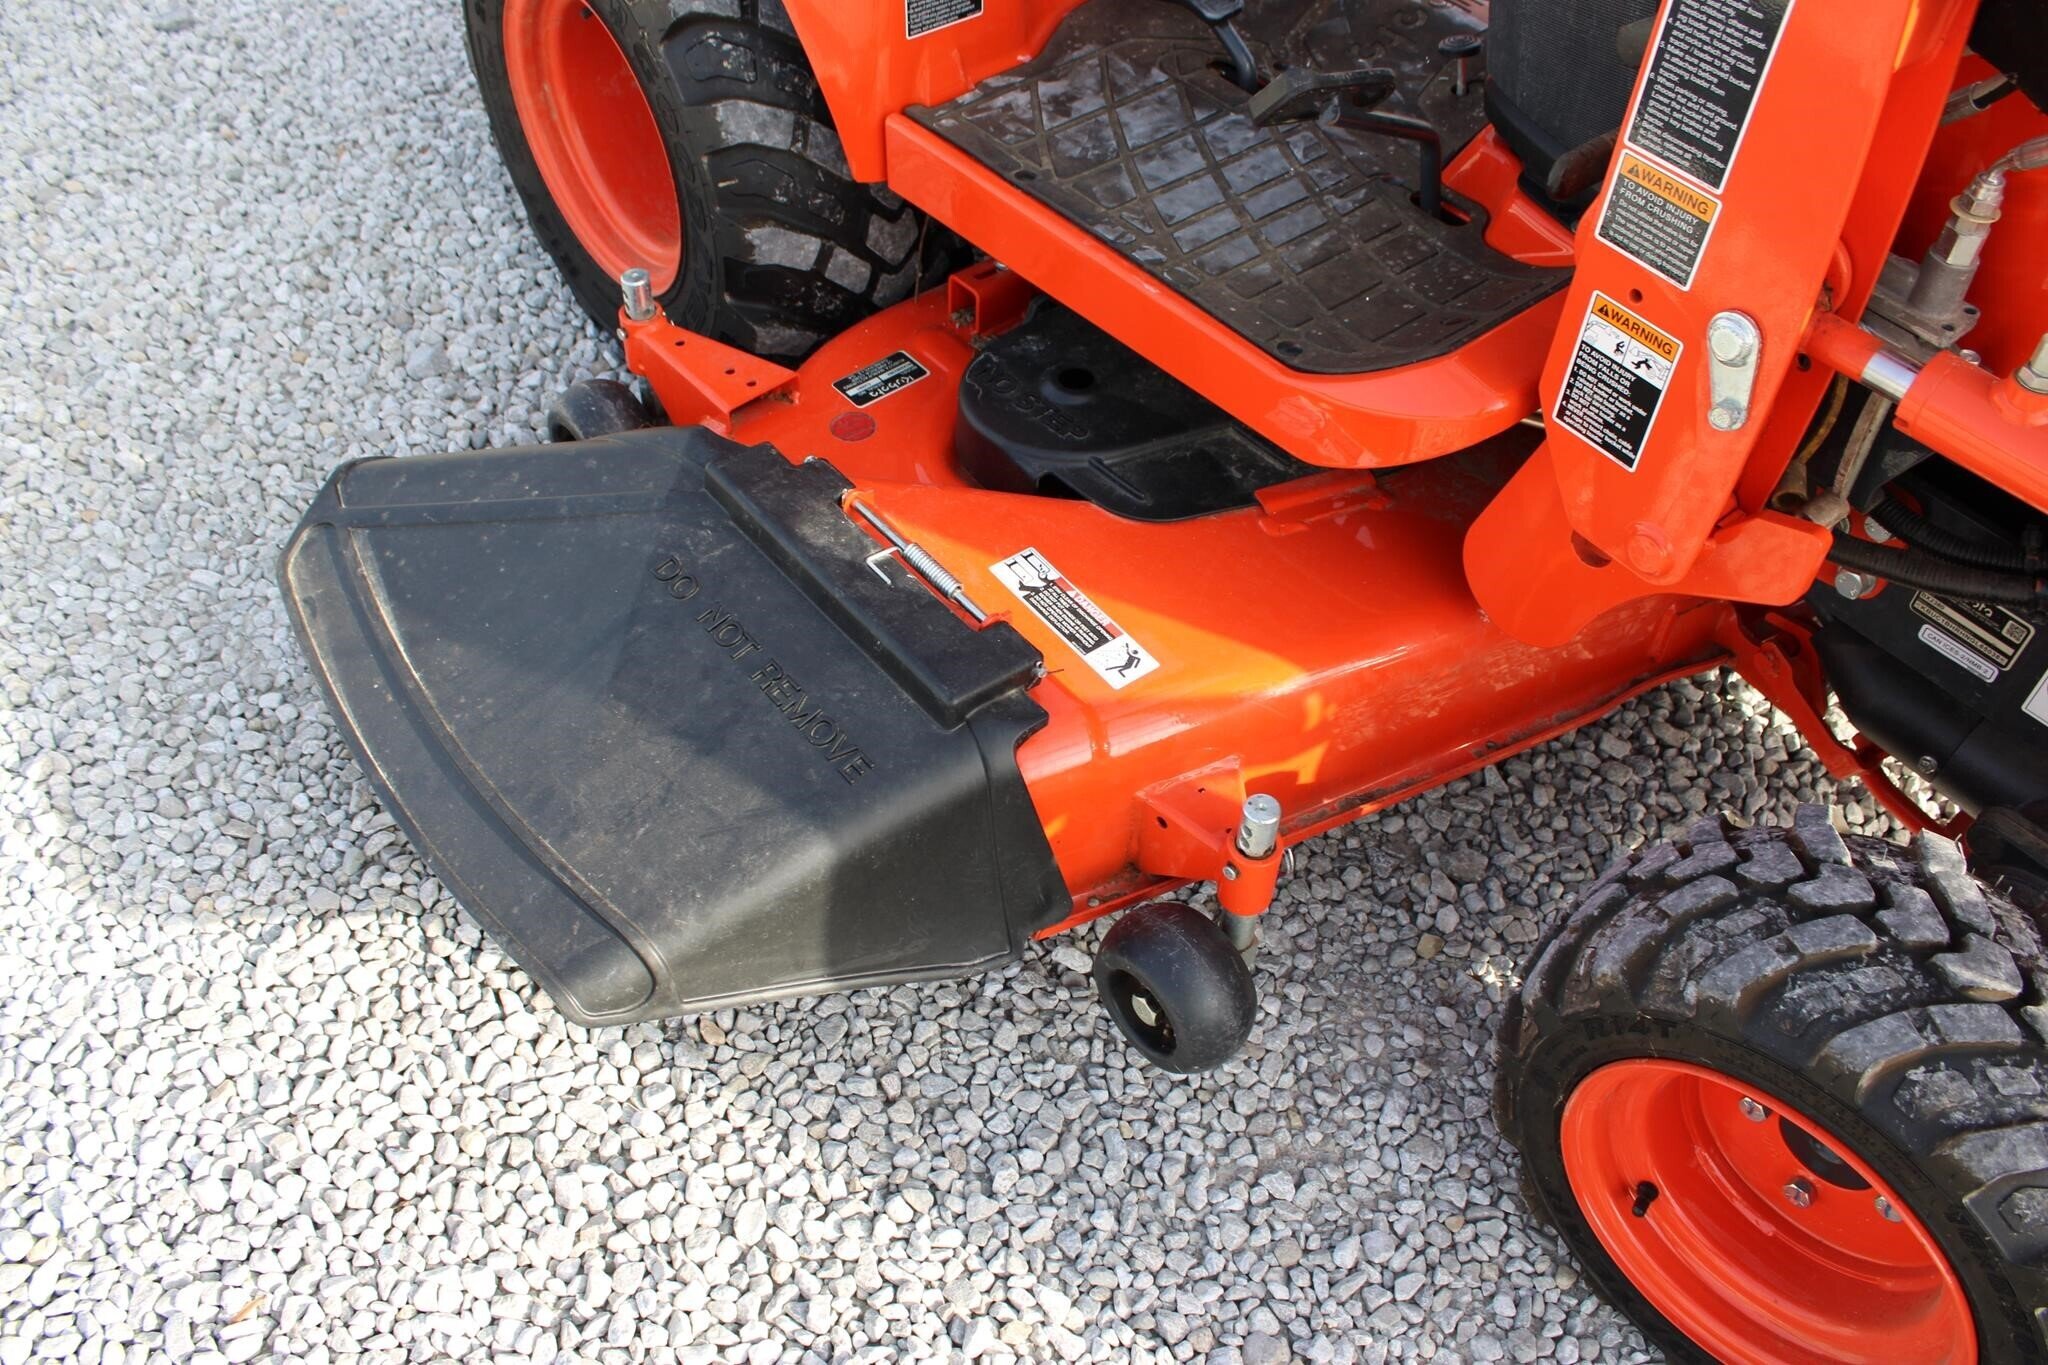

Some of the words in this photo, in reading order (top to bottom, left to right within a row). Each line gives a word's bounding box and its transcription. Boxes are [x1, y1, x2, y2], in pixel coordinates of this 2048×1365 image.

[1619, 186, 1645, 207] FROM
[1622, 177, 1635, 190] TO
[1636, 185, 1664, 206] AVOID
[1664, 202, 1699, 226] INJURY
[1639, 167, 1711, 216] WARNING
[1608, 308, 1674, 356] WARNING
[1575, 357, 1597, 375] BEING
[1596, 370, 1632, 397] CRUSHED:
[1578, 350, 1598, 367] FROM
[1597, 362, 1619, 381] FALLS
[1619, 376, 1630, 387] OR
[1580, 342, 1591, 354] TO
[1590, 349, 1612, 367] AVOID
[1611, 362, 1636, 382] INJURY
[869, 375, 915, 397] Kubota
[1011, 395, 1089, 440] STEP
[1073, 594, 1111, 626] DANGER
[1925, 631, 1943, 645] CAN
[650, 555, 699, 601] DO
[696, 601, 763, 663] NOT
[751, 657, 875, 785] REMOVE
